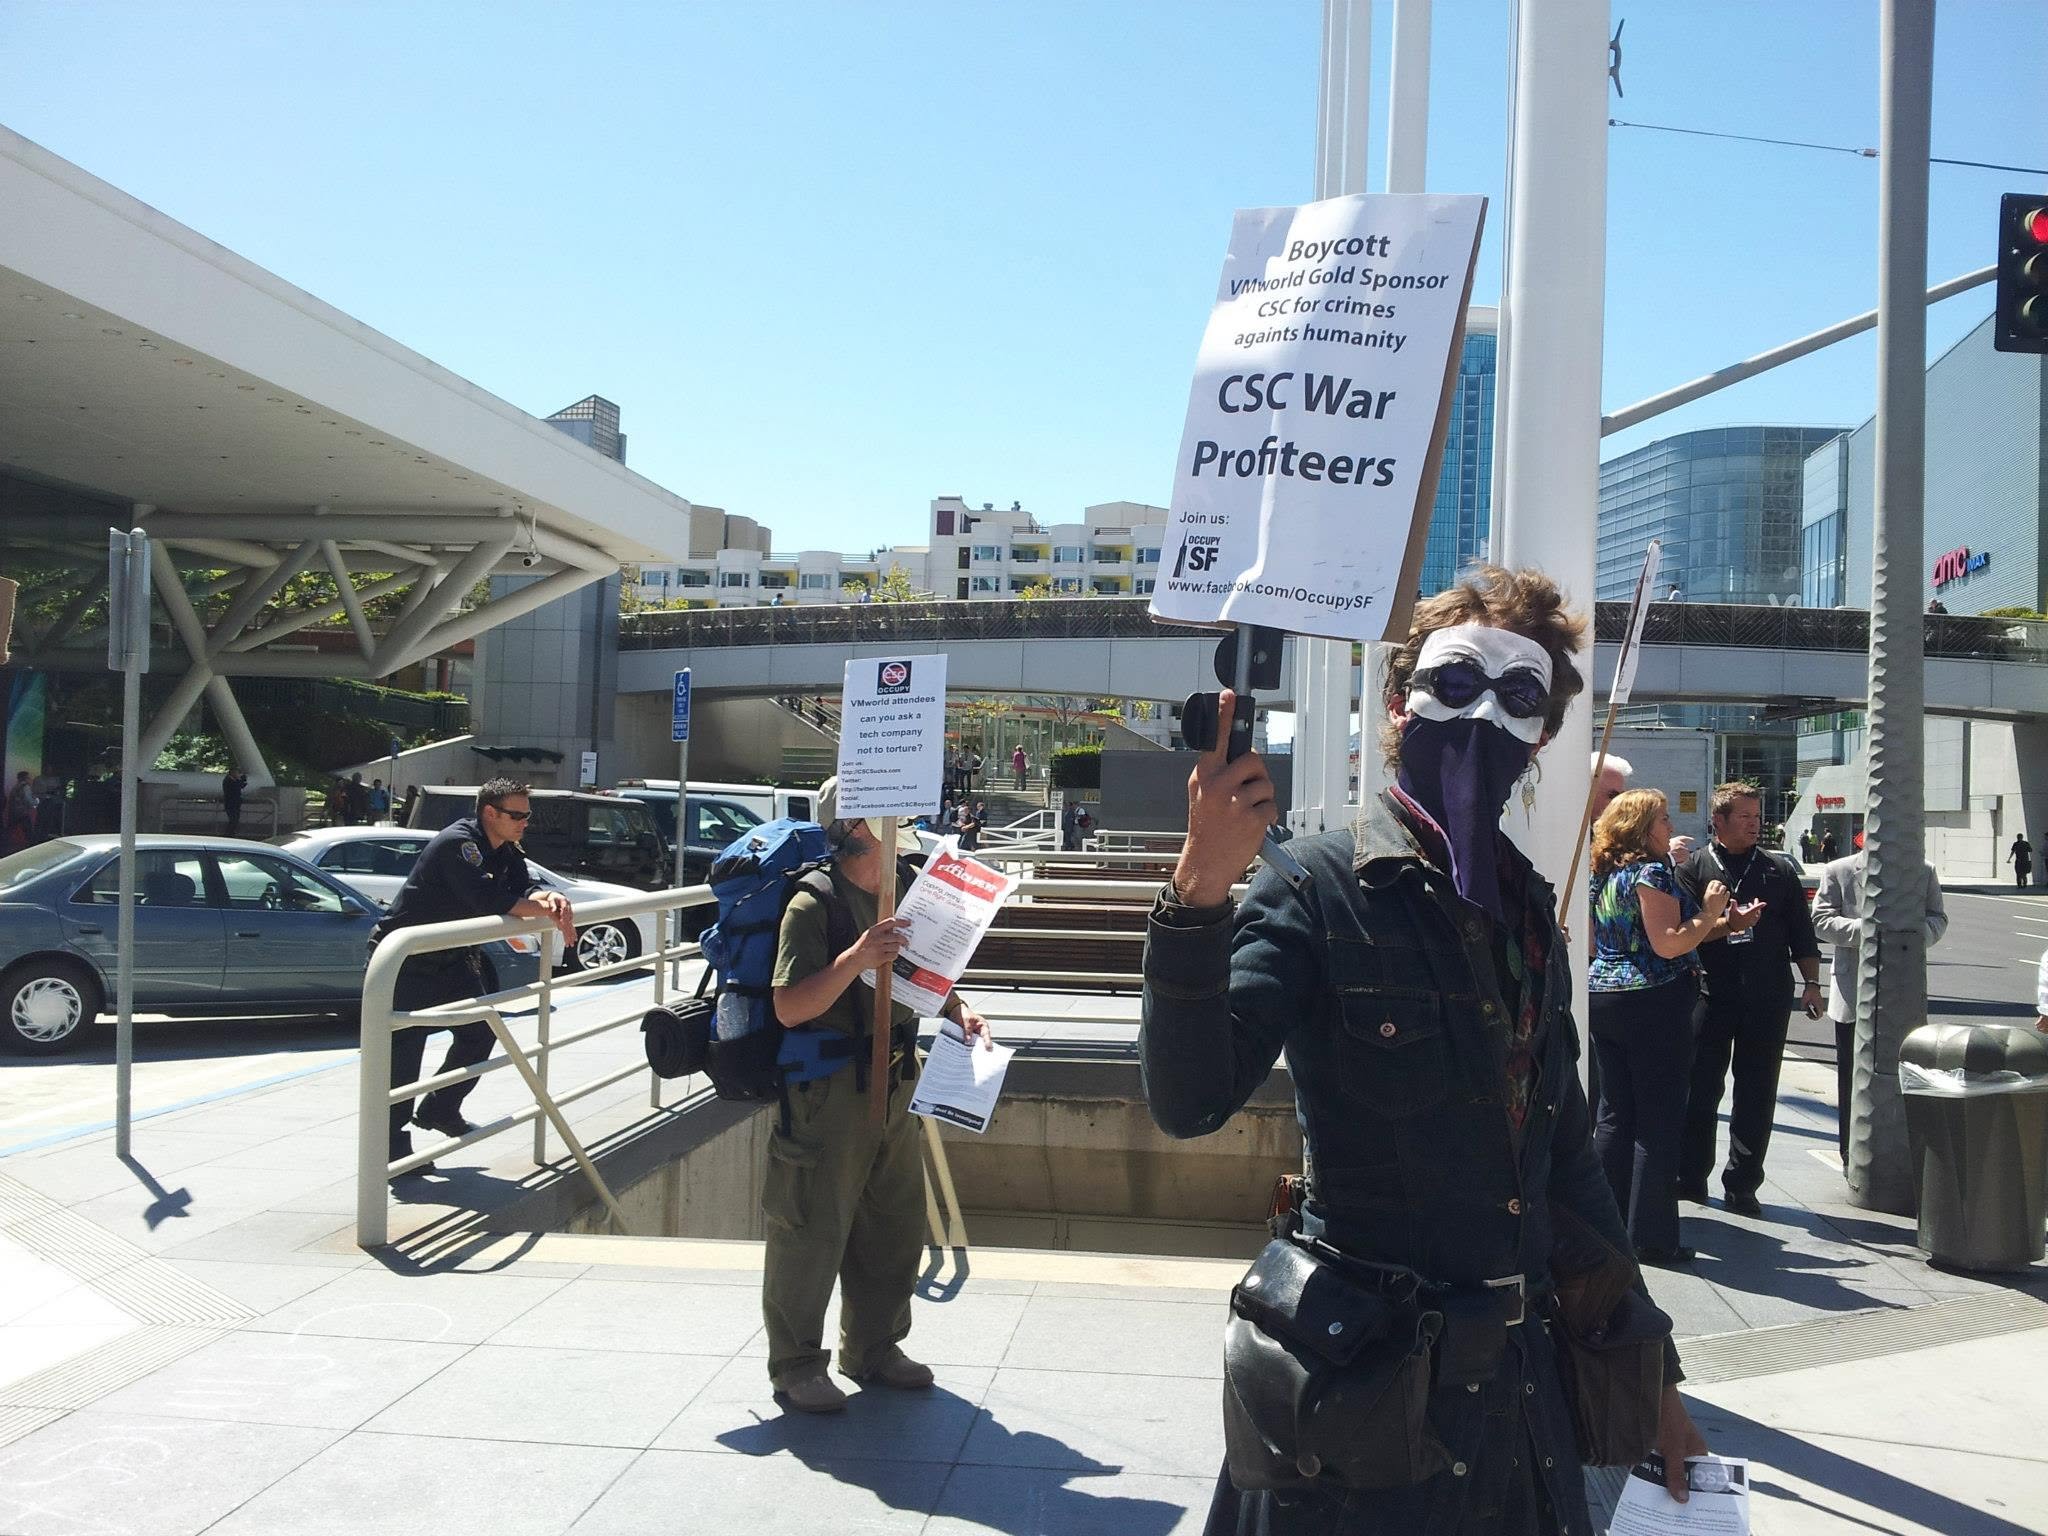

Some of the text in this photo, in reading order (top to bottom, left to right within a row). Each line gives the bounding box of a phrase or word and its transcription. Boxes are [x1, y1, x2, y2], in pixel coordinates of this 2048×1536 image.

[1288, 234, 1390, 263] Boycott
[1230, 266, 1449, 296] VMworld Gold Sponsor
[1257, 296, 1396, 319] CSC for crimes
[1234, 324, 1407, 353] againts humanity
[1217, 372, 1396, 420] CSC War
[1191, 435, 1397, 487] Profiteers
[1179, 511, 1230, 525] Join us:
[1188, 535, 1222, 546] OCCUPY
[1188, 547, 1220, 571] SF
[878, 686, 910, 694] OCCUPY
[851, 696, 936, 707] VMworld attendees
[879, 714, 896, 723] you
[898, 712, 914, 721] ask
[860, 729, 923, 739] tech company
[857, 744, 923, 755] not to torture?
